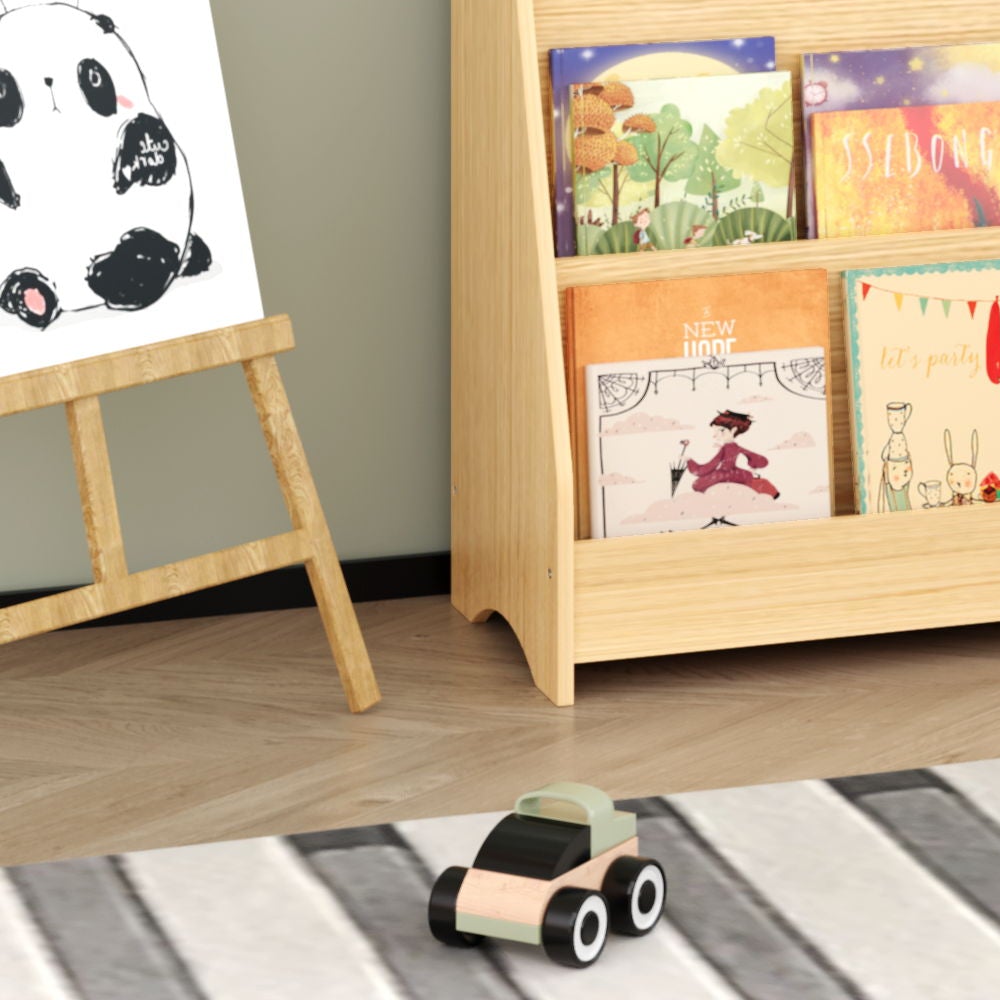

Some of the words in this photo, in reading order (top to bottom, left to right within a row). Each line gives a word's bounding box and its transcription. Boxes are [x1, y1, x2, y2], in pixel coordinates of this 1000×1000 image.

[840, 127, 994, 182] SSEBONG
[683, 318, 737, 340] NEW
[925, 343, 981, 379] party
